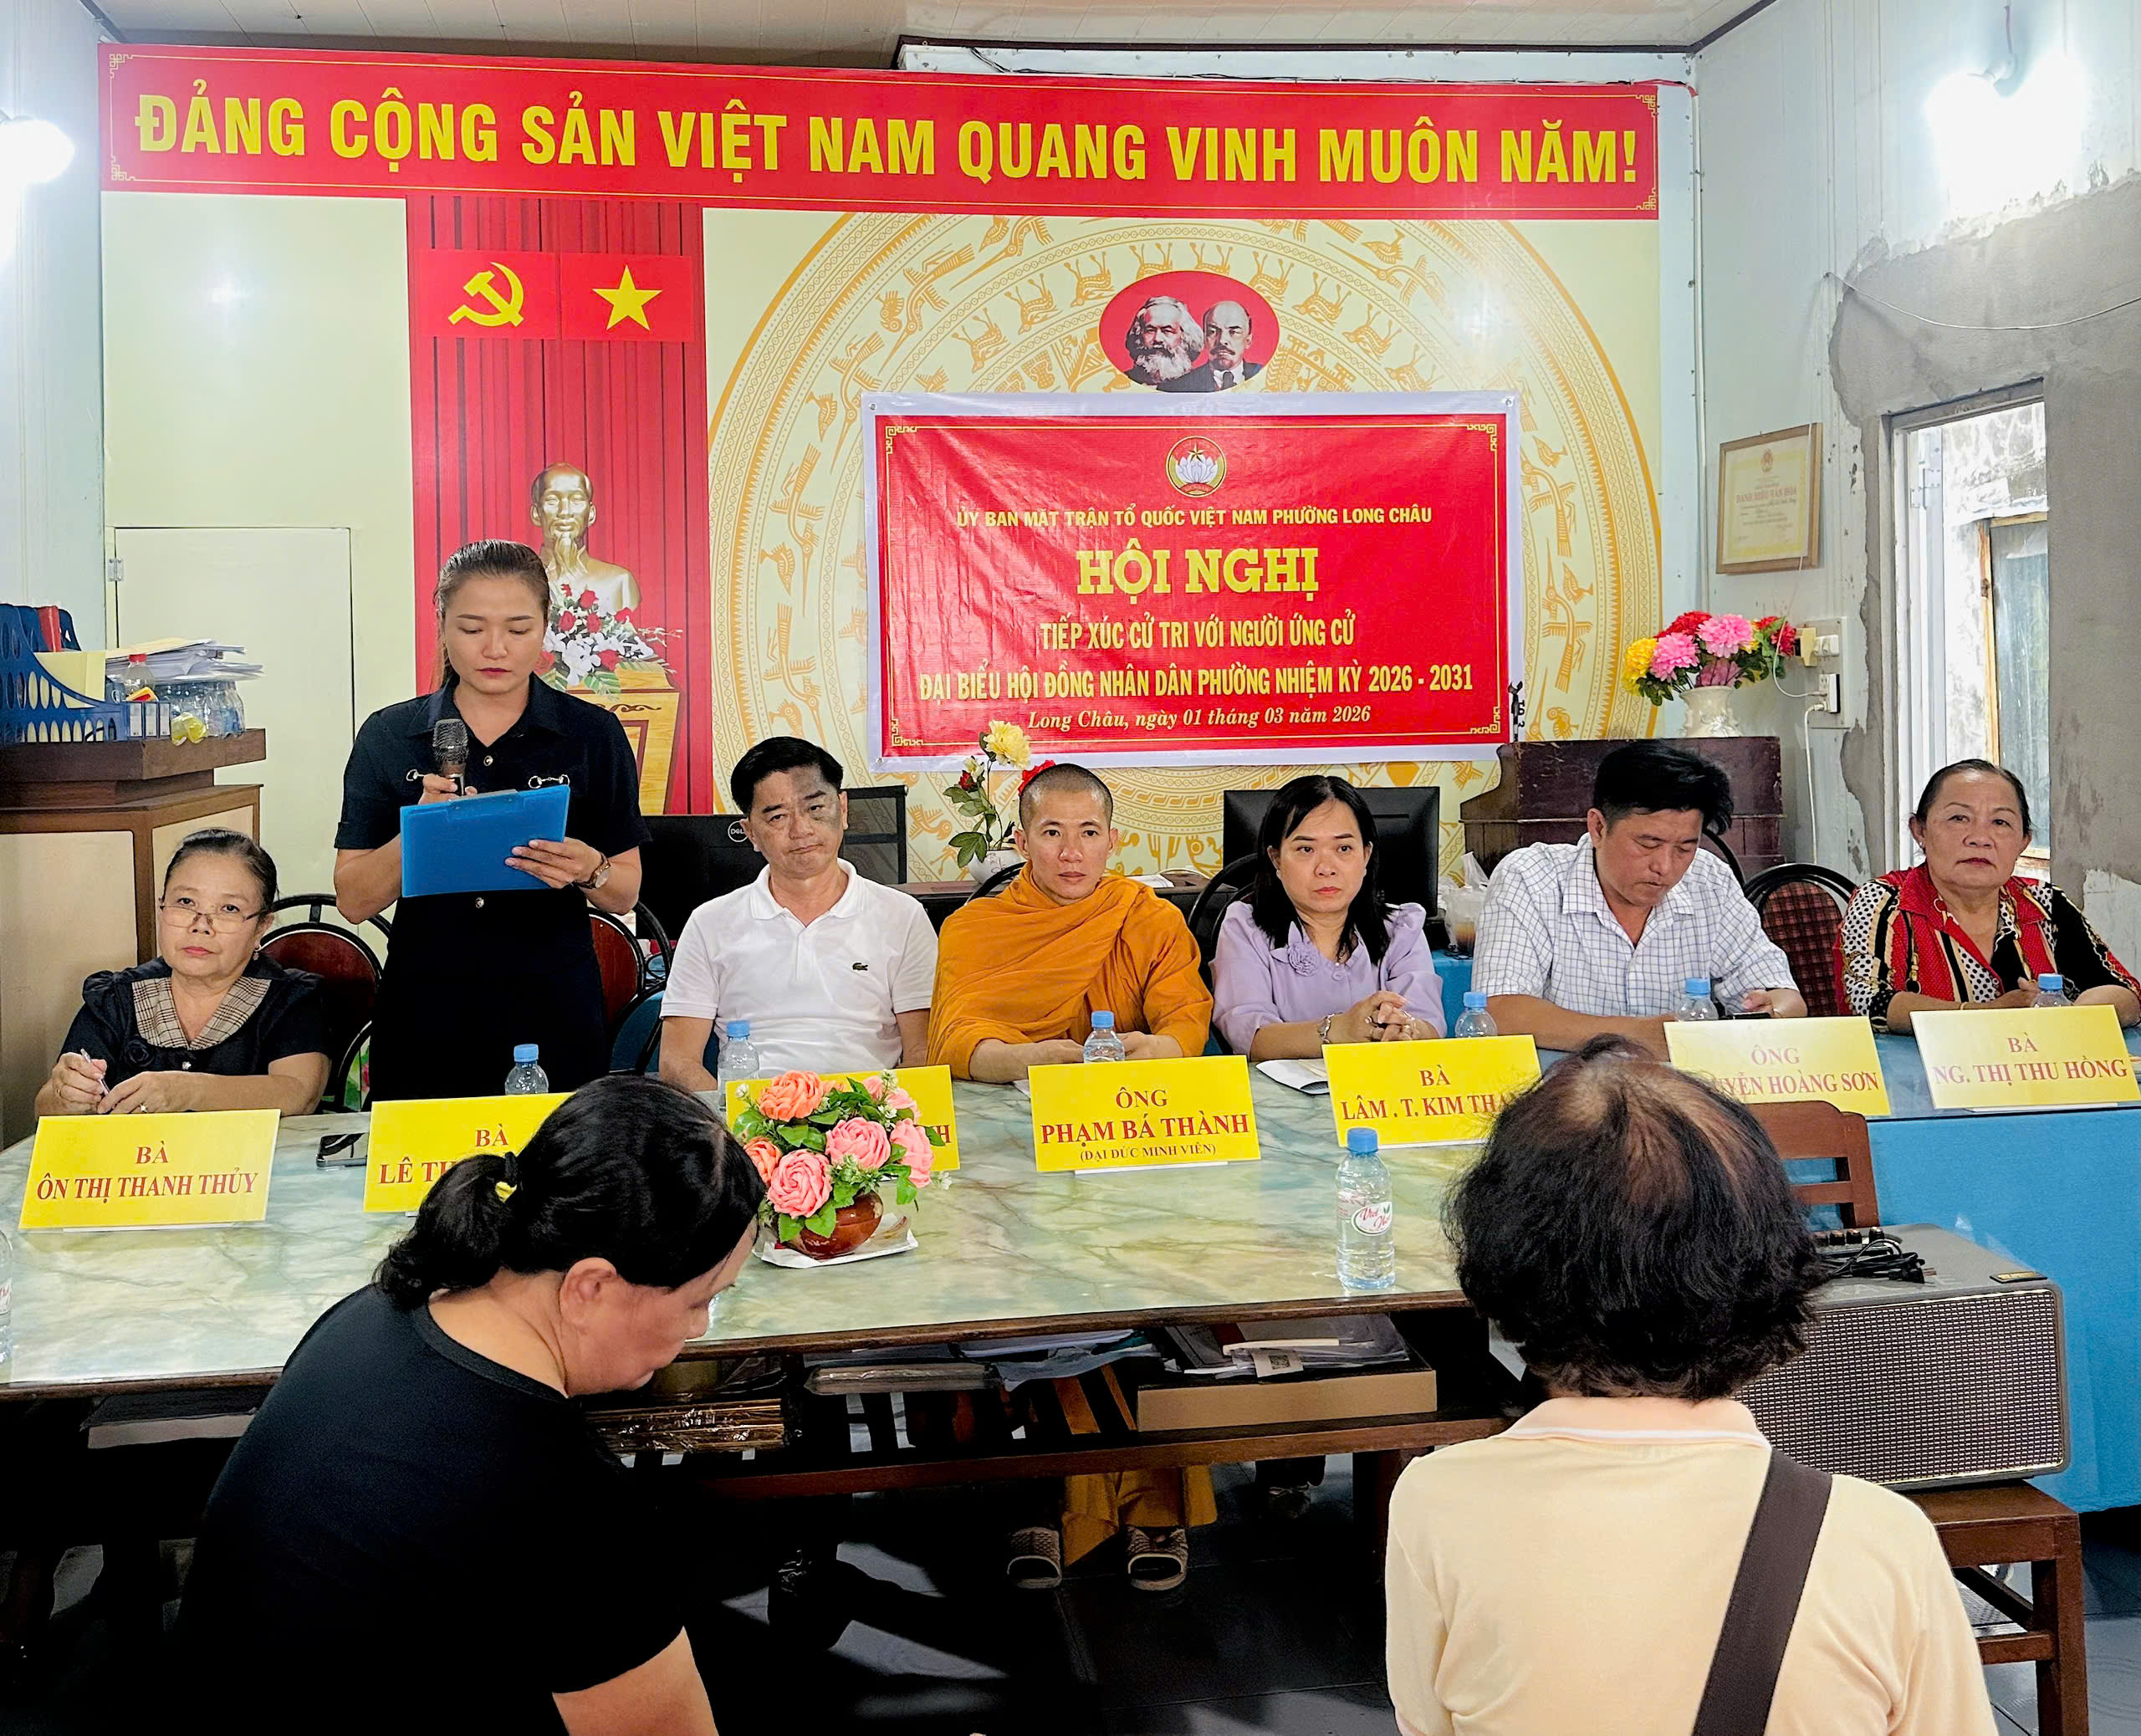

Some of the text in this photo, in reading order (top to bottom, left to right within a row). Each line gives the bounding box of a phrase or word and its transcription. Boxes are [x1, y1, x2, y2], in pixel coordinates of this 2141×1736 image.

[135, 79, 1637, 185] ĐẢNG CỘNG SẢN VIỆT NAM QUANG VINH MUÔN NĂM!
[957, 506, 979, 528] ỦY
[984, 510, 1019, 527] BAN
[1064, 507, 1109, 528] TRẬN
[1114, 503, 1137, 526] TỔ
[1141, 504, 1185, 527] QUỐC
[1189, 506, 1226, 528] VIỆT
[1232, 508, 1267, 525] NAM
[1272, 505, 1338, 525] PHƯỜNG
[1342, 507, 1384, 523] LONG
[1388, 503, 1432, 523] CHÂU
[1076, 538, 1320, 605] HỘI NGHỊ
[1040, 609, 1356, 651] TIẾP XÚC CỬ TRI VỚI NGƯỜI ỨNG CỬ
[920, 672, 951, 705] ĐẠI
[958, 658, 1001, 701] BIỂU
[1007, 665, 1039, 704] HỘI
[1044, 659, 1095, 698] ĐỒNG
[1100, 663, 1150, 697] NHÂN
[1155, 662, 1192, 697] DÂN
[1198, 661, 1270, 696] PHƯỜNG
[1275, 660, 1332, 699] NHIỆM
[1338, 659, 1362, 692] KỲ
[1368, 665, 1413, 692] 2026
[1429, 664, 1473, 691] 2031
[1028, 705, 1372, 731] Long Châu, ngày 01 tháng 03 năm 2026
[1751, 1044, 1800, 1065] ÔNG
[2007, 1032, 2038, 1053] BÀ
[1419, 1065, 1451, 1086] BÀ
[1768, 1070, 1837, 1095] HOÀNG
[1841, 1072, 1879, 1091] SƠN
[1932, 1065, 1970, 1084] NG.
[1973, 1064, 2013, 1086] THỊ
[2015, 1062, 2059, 1080] THU
[1116, 1086, 1168, 1108] ÔNG
[1341, 1095, 1387, 1120] LÂM
[1423, 1096, 1464, 1116] KIM
[475, 1124, 508, 1147] BÀ
[1040, 1111, 1250, 1147] PHẠM BÁ THÀNH
[135, 1141, 168, 1164] BÀ
[1142, 1143, 1178, 1157] MINH
[381, 1156, 413, 1184] LÊ
[36, 1167, 259, 1203] ÔN THỊ THANH THỦY
